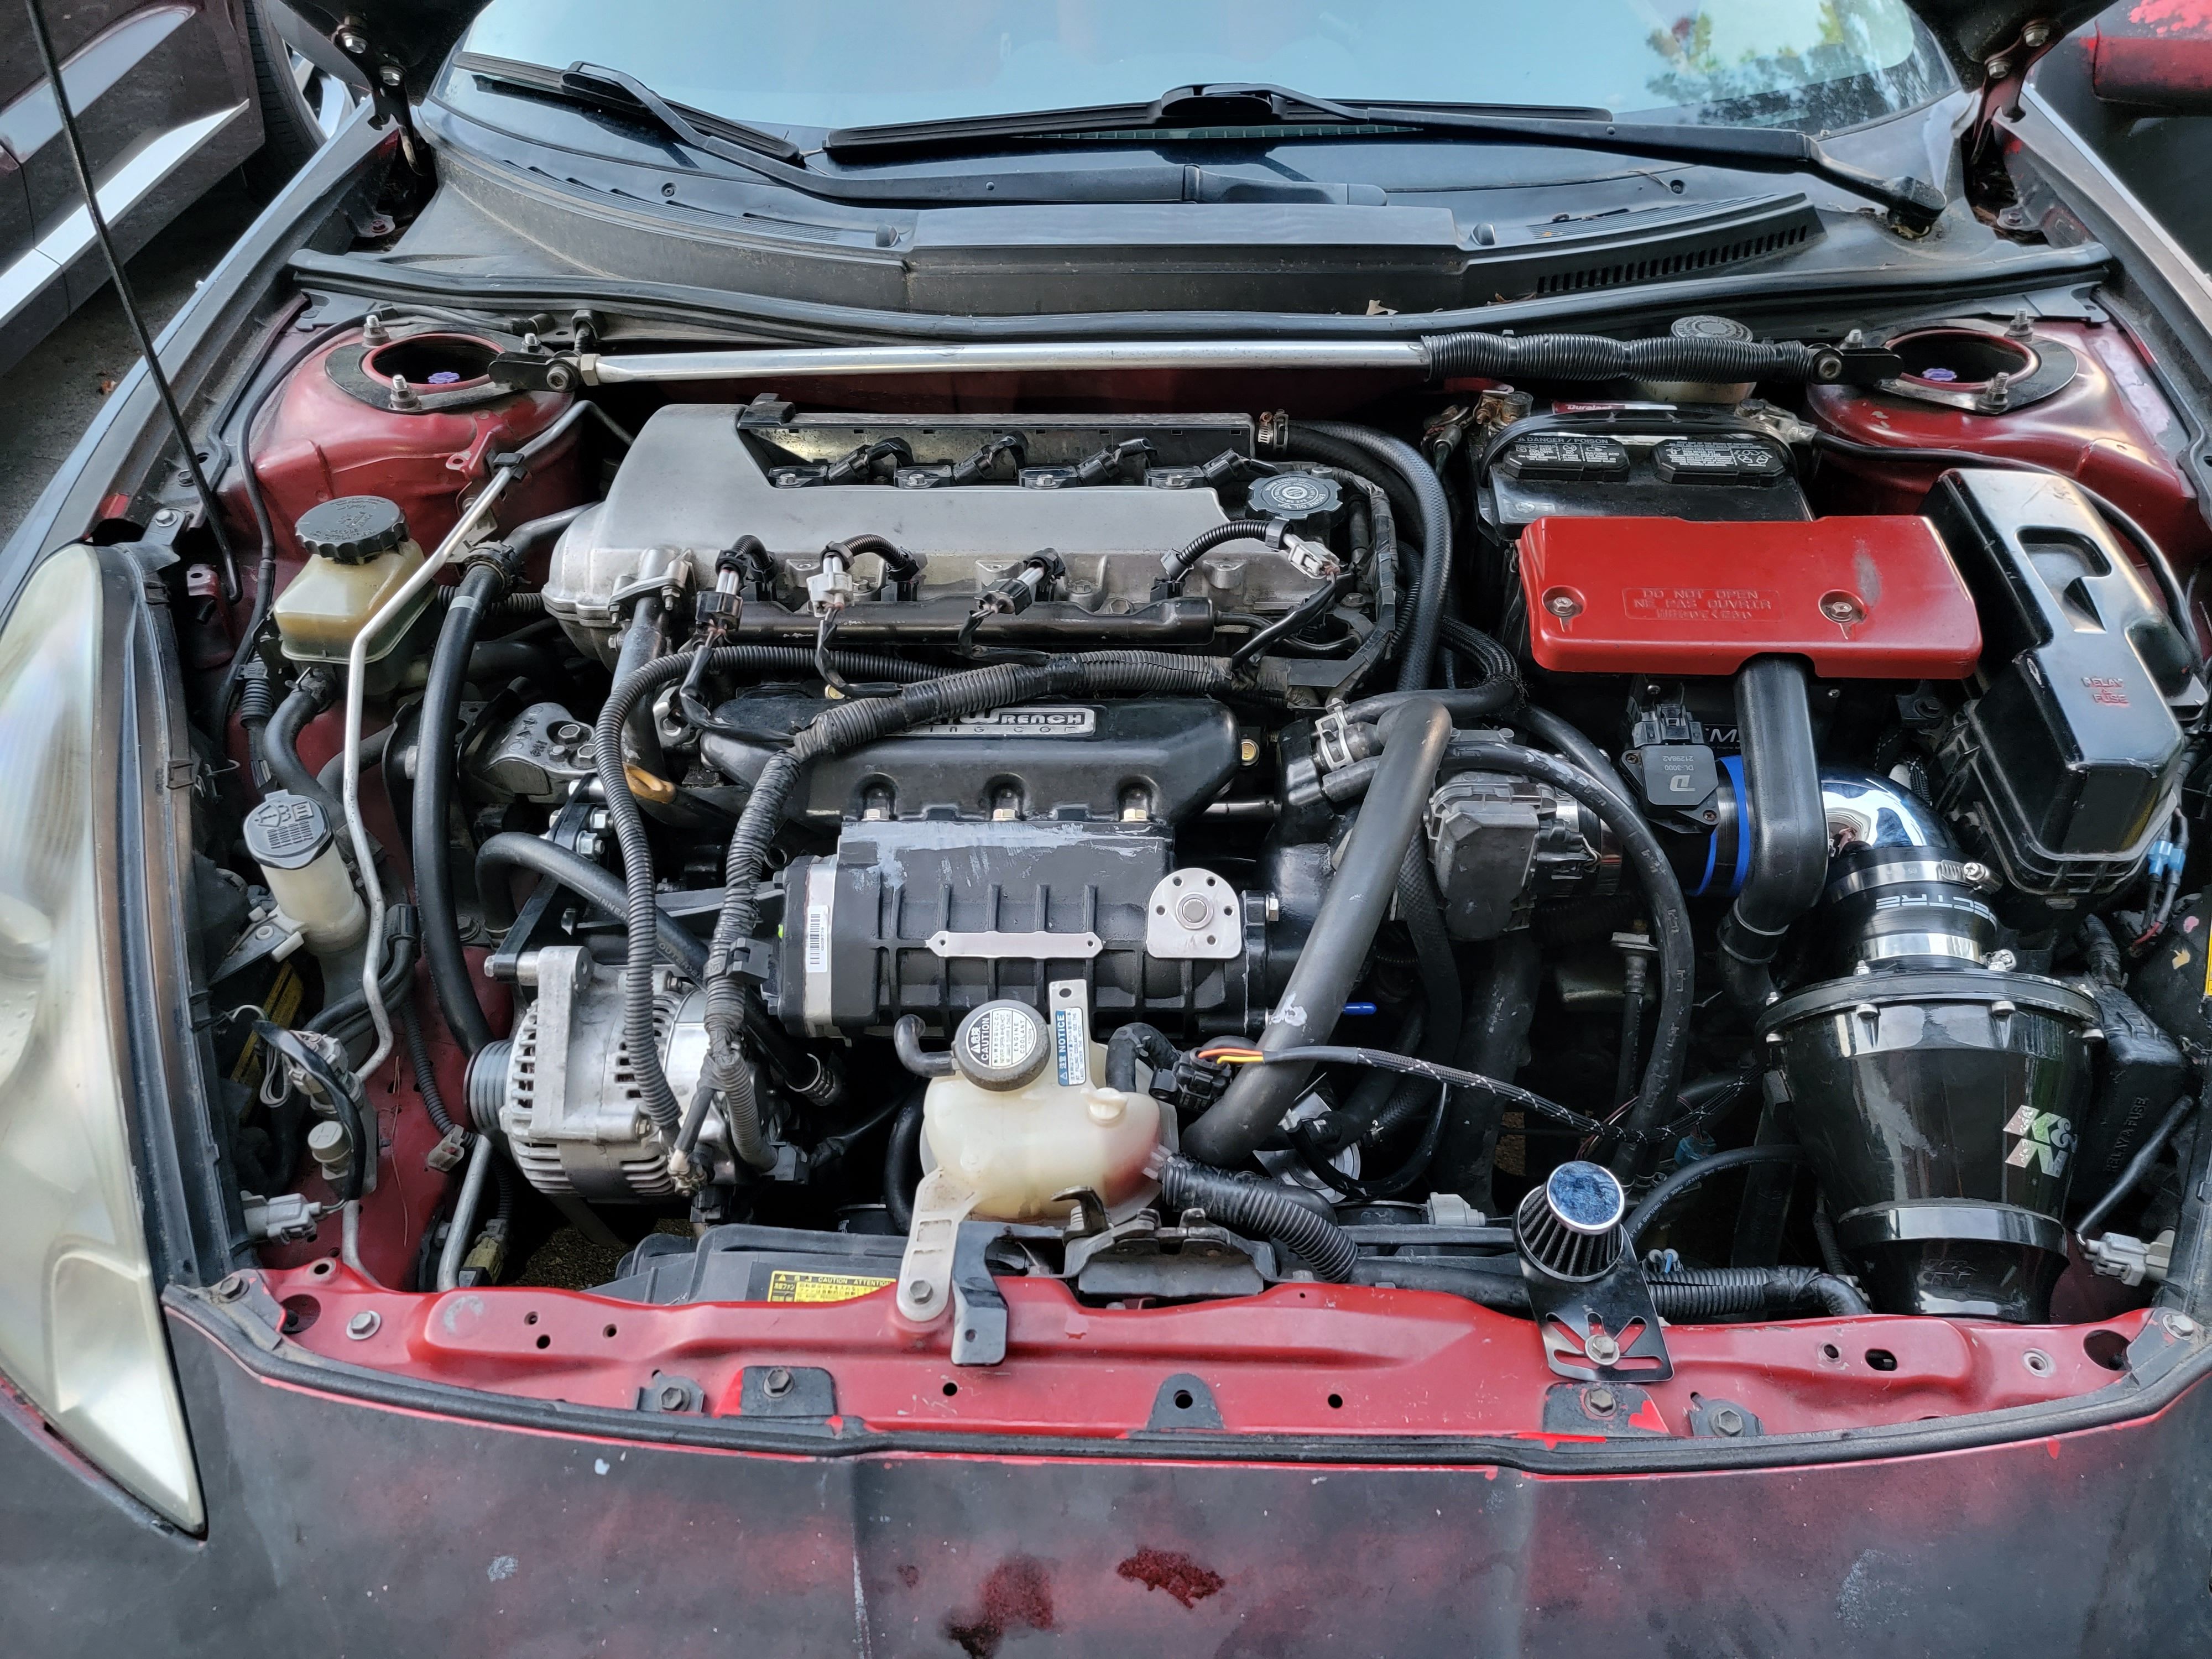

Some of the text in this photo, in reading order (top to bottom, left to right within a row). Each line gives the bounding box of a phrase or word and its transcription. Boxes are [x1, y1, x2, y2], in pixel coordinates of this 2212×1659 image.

[1307, 493, 1326, 507] ENGINE
[1642, 589, 1759, 599] DO NOT OPEN
[1634, 599, 1772, 609] NE PAS OUVRIR
[2081, 677, 2124, 688] RELAY
[2092, 694, 2130, 704] FUSE
[598, 896, 627, 920] INNER
[971, 1026, 981, 1044] 危険
[981, 1017, 990, 1061] CAUTION
[1057, 1014, 1066, 1053] NOTICE
[2131, 1097, 2150, 1128] FUSE
[2003, 1104, 2078, 1178] K&N
[1662, 1195, 1669, 1203] IN
[1642, 1202, 1663, 1223] THAILAND
